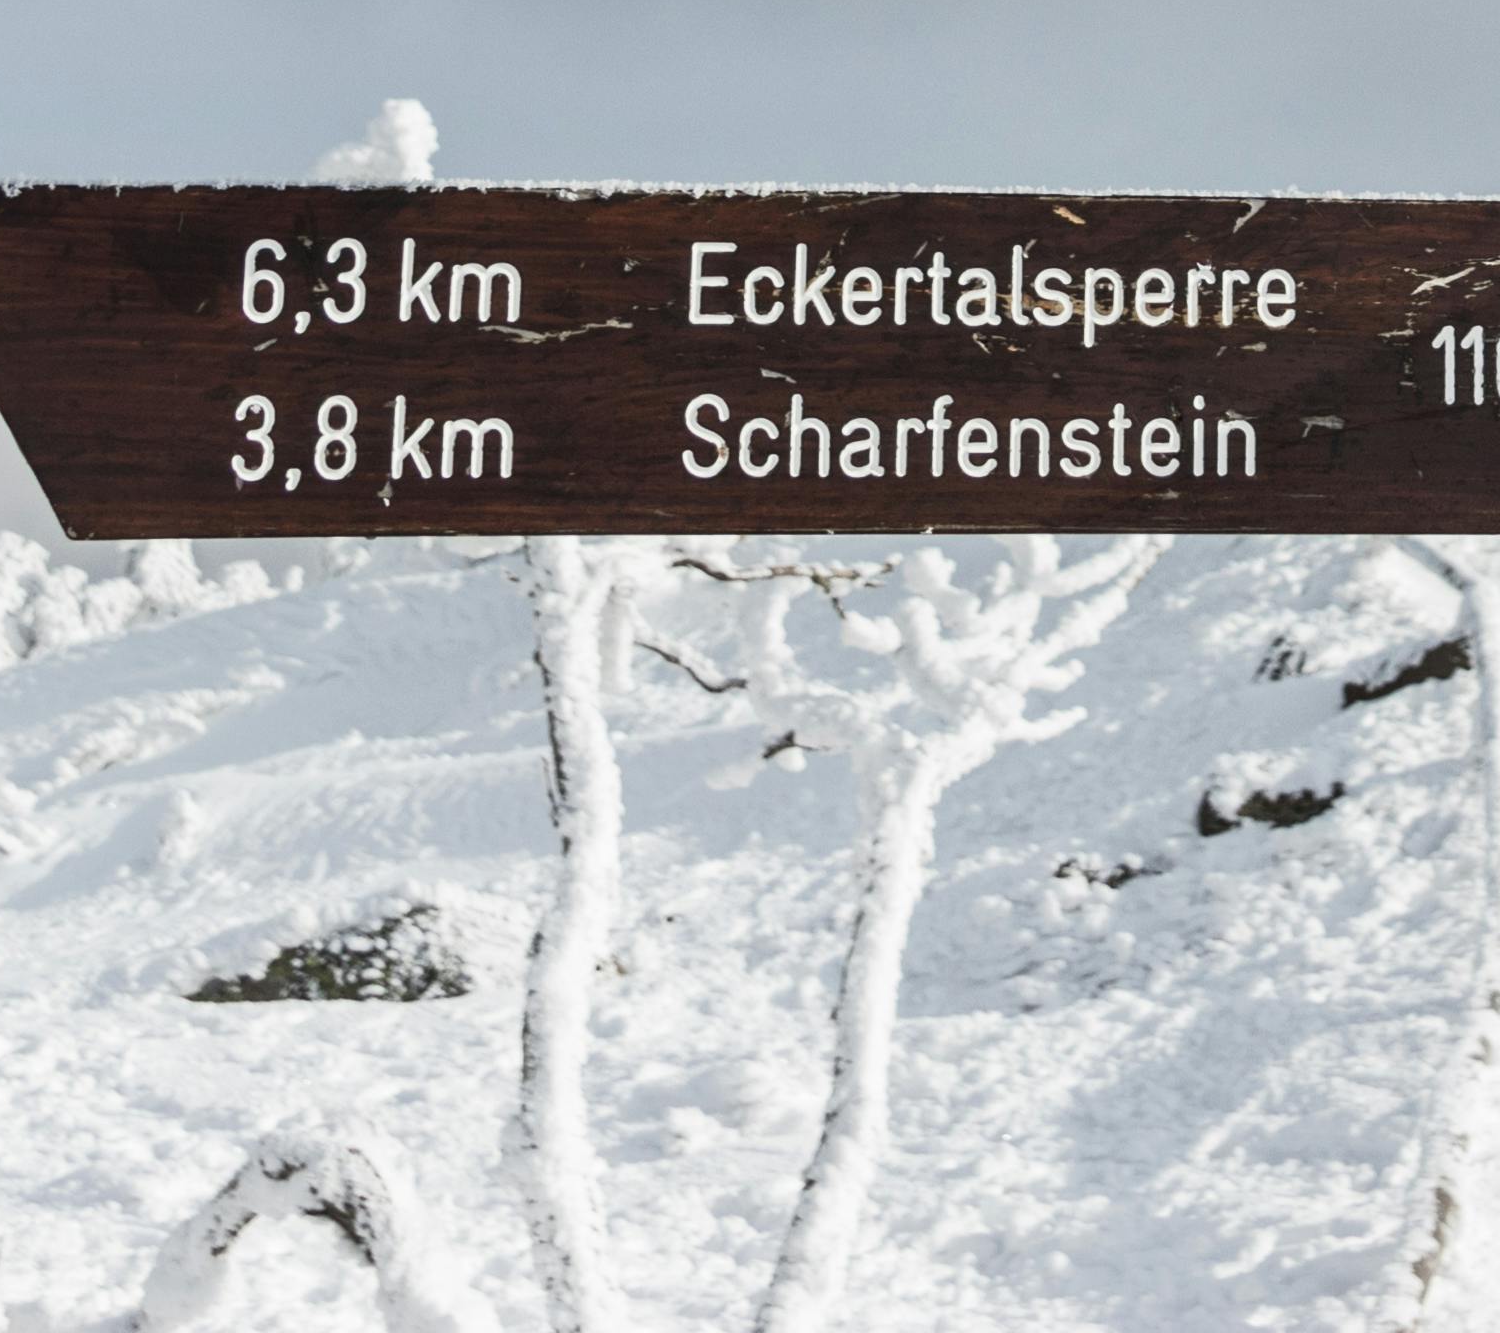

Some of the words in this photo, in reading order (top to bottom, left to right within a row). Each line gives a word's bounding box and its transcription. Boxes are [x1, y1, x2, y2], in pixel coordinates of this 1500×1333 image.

[242, 237, 367, 334] 6,3
[399, 237, 522, 323] km
[688, 242, 1296, 348] Eckertalsperre
[231, 394, 358, 491] 3,8
[391, 394, 513, 480] km
[682, 393, 1256, 479] Scharfenstein
